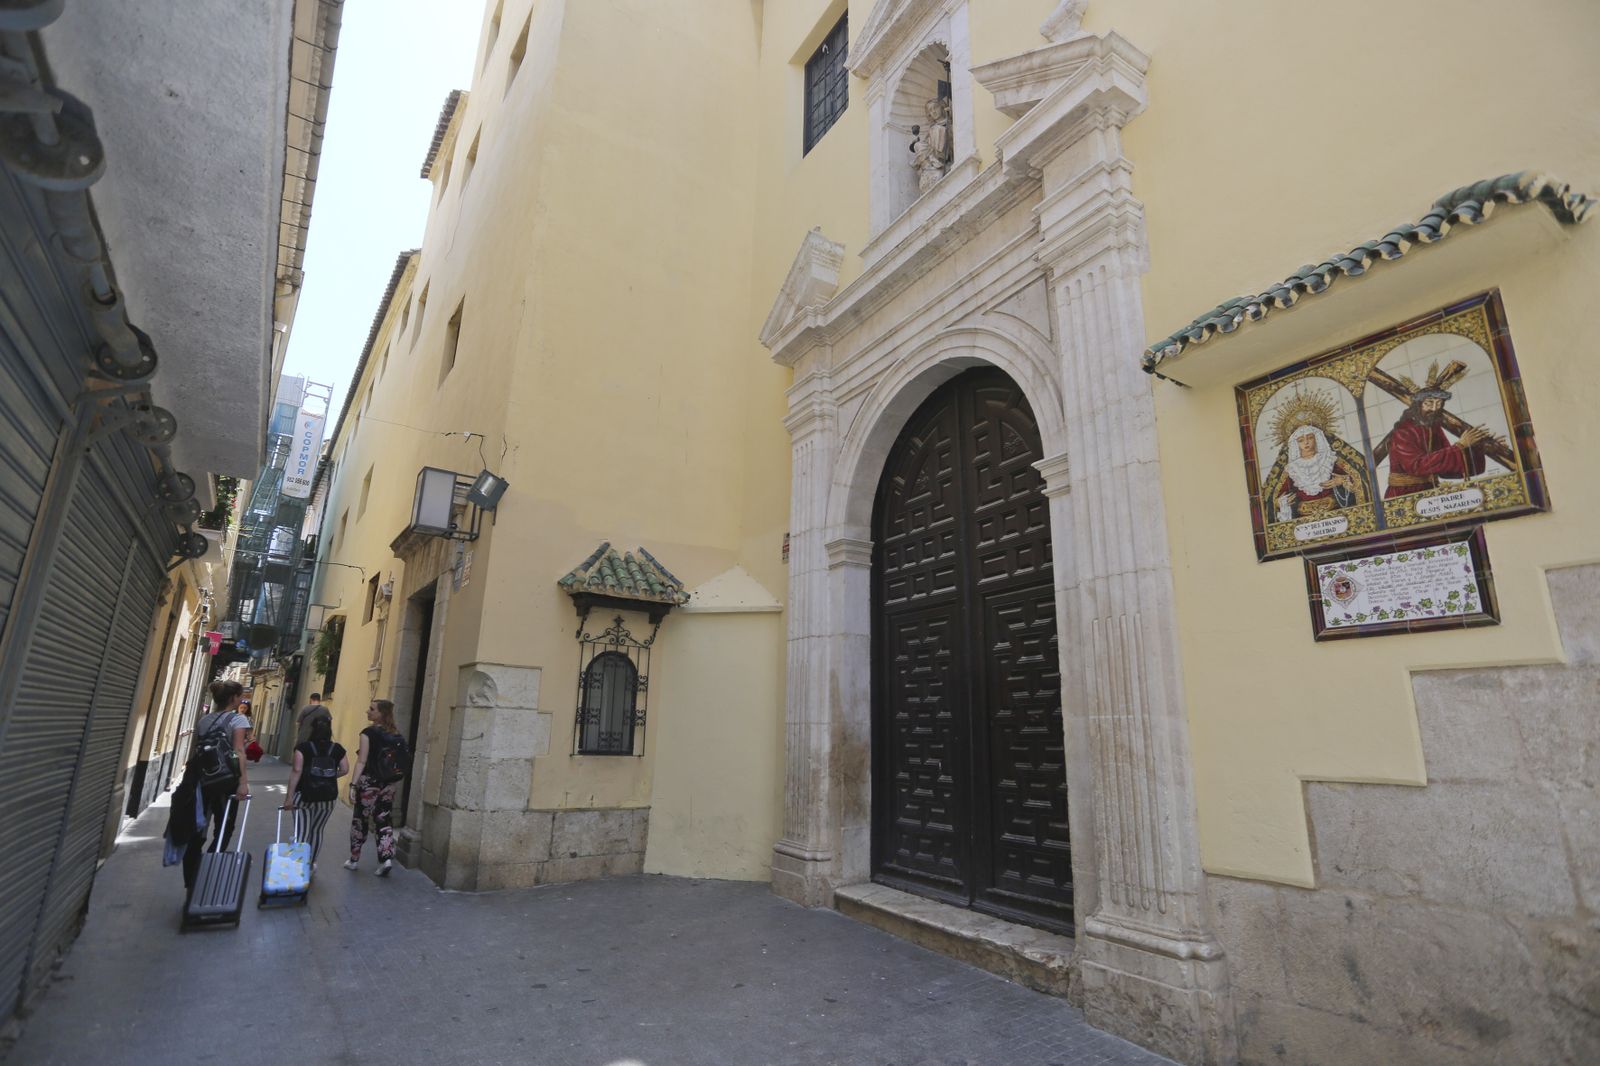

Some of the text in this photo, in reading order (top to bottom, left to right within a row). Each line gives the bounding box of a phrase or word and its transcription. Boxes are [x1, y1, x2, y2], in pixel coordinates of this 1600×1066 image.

[298, 431, 312, 475] COPMOR
[1443, 498, 1481, 510] NAZARENO
[1312, 527, 1337, 536] SOLEDAD
